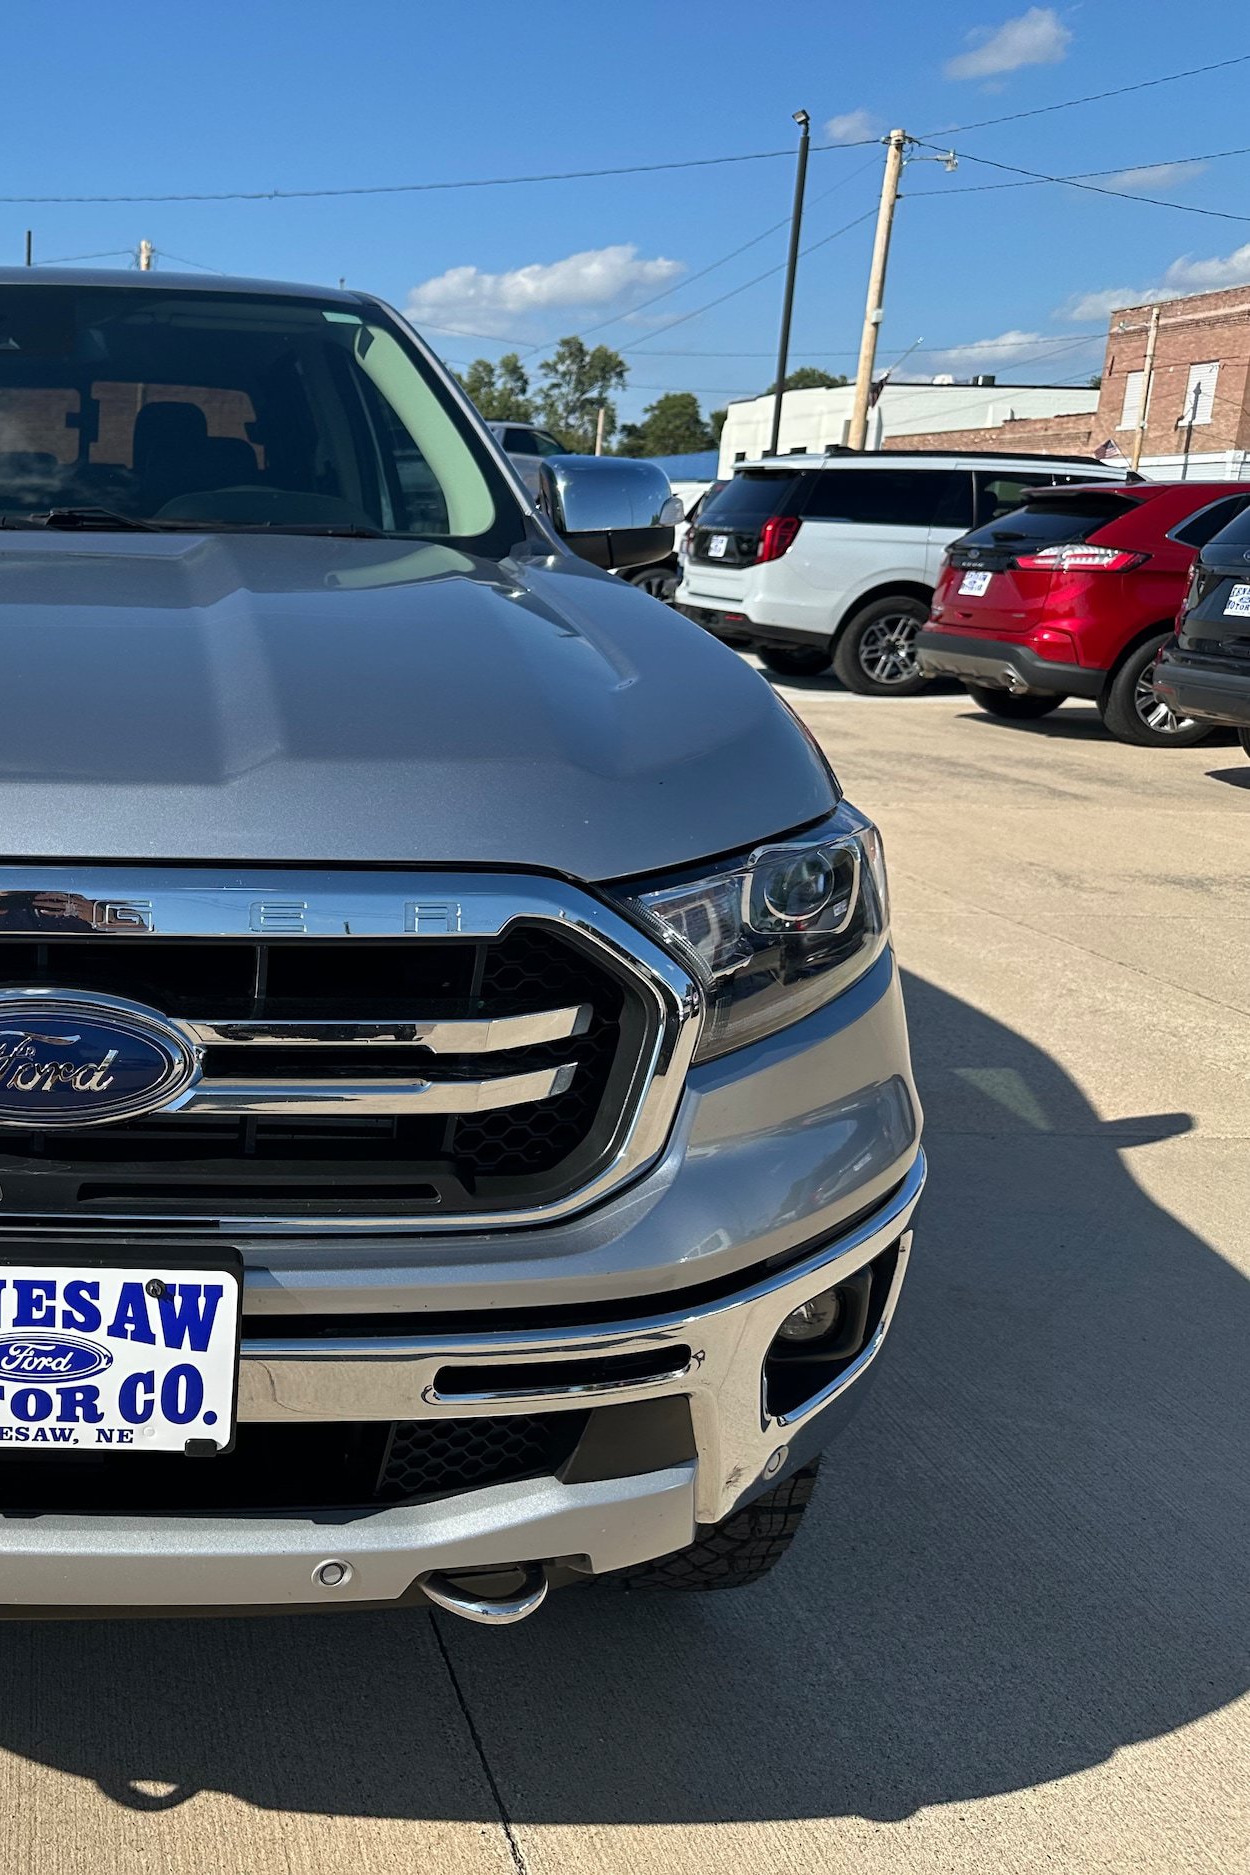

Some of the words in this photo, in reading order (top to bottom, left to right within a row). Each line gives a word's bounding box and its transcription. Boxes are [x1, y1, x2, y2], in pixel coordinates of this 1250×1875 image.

[0, 1342, 75, 1372] Ford
[117, 1362, 218, 1426] CO.
[95, 1428, 134, 1444] NE
